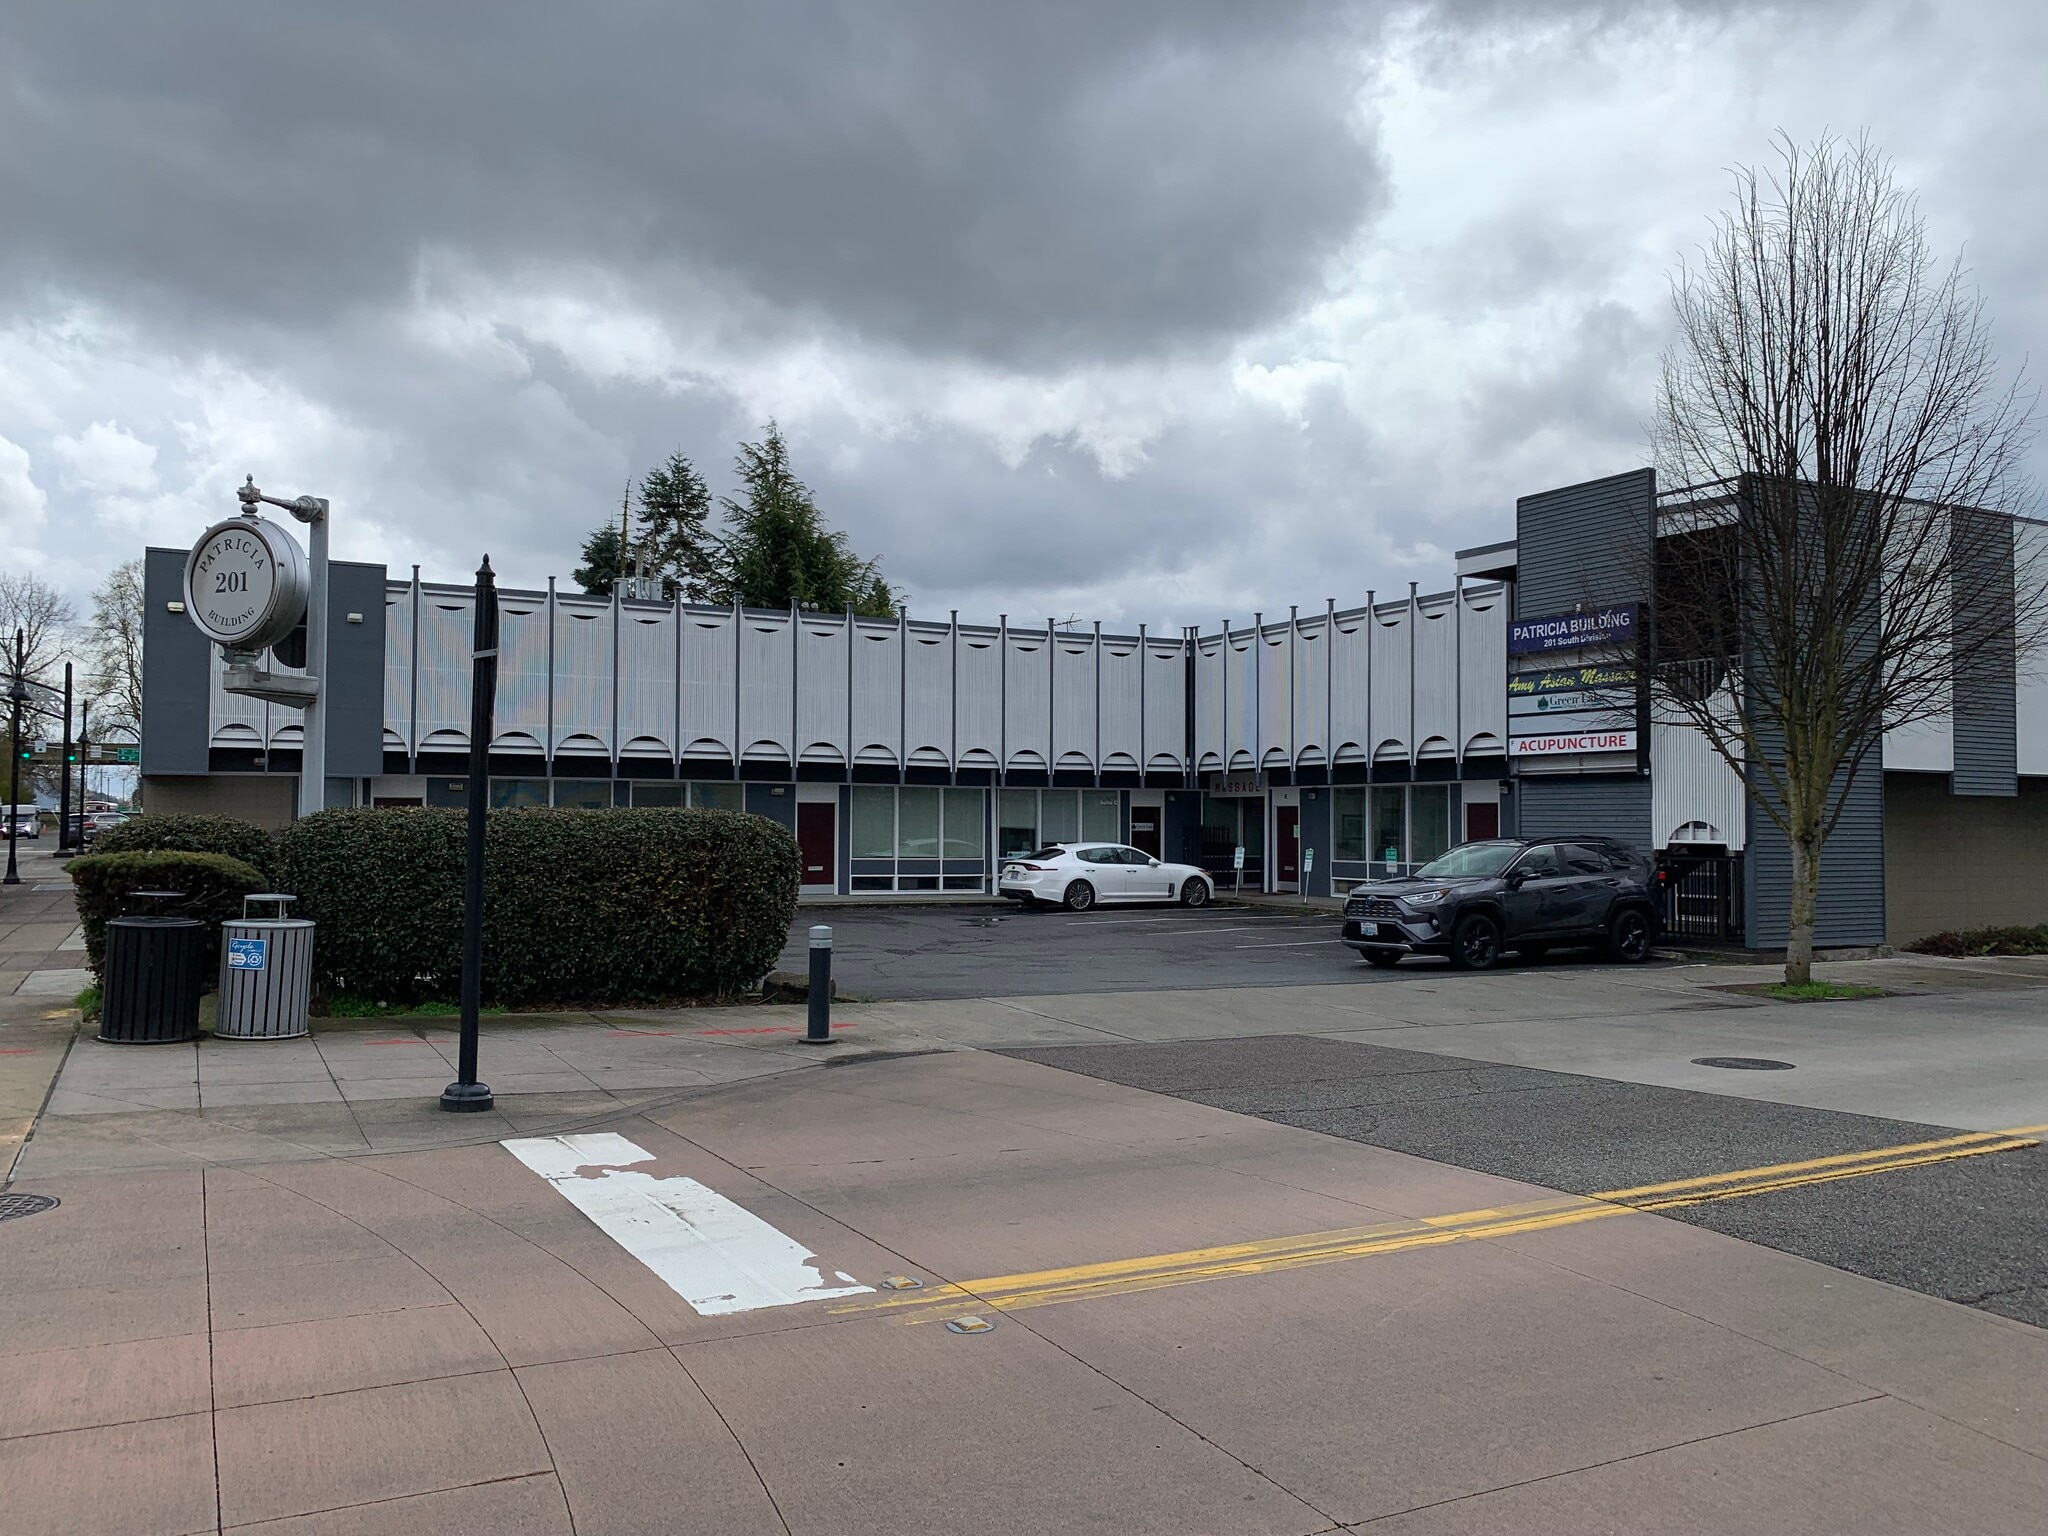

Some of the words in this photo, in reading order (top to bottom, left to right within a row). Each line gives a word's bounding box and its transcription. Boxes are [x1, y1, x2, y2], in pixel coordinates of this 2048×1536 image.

[199, 538, 264, 573] PATRICIA
[215, 571, 249, 594] 201
[208, 606, 255, 626] BUILDING
[1513, 621, 1568, 641] PATRICIA
[1570, 612, 1630, 633] BUILDING
[1543, 638, 1557, 648] 201
[1558, 634, 1580, 647] South
[1508, 676, 1535, 693] Amy
[1538, 673, 1576, 691] Asian
[1549, 694, 1579, 706] Green
[1519, 734, 1628, 752] ACUPUNCTURE
[1214, 781, 1261, 793] MASSAGE
